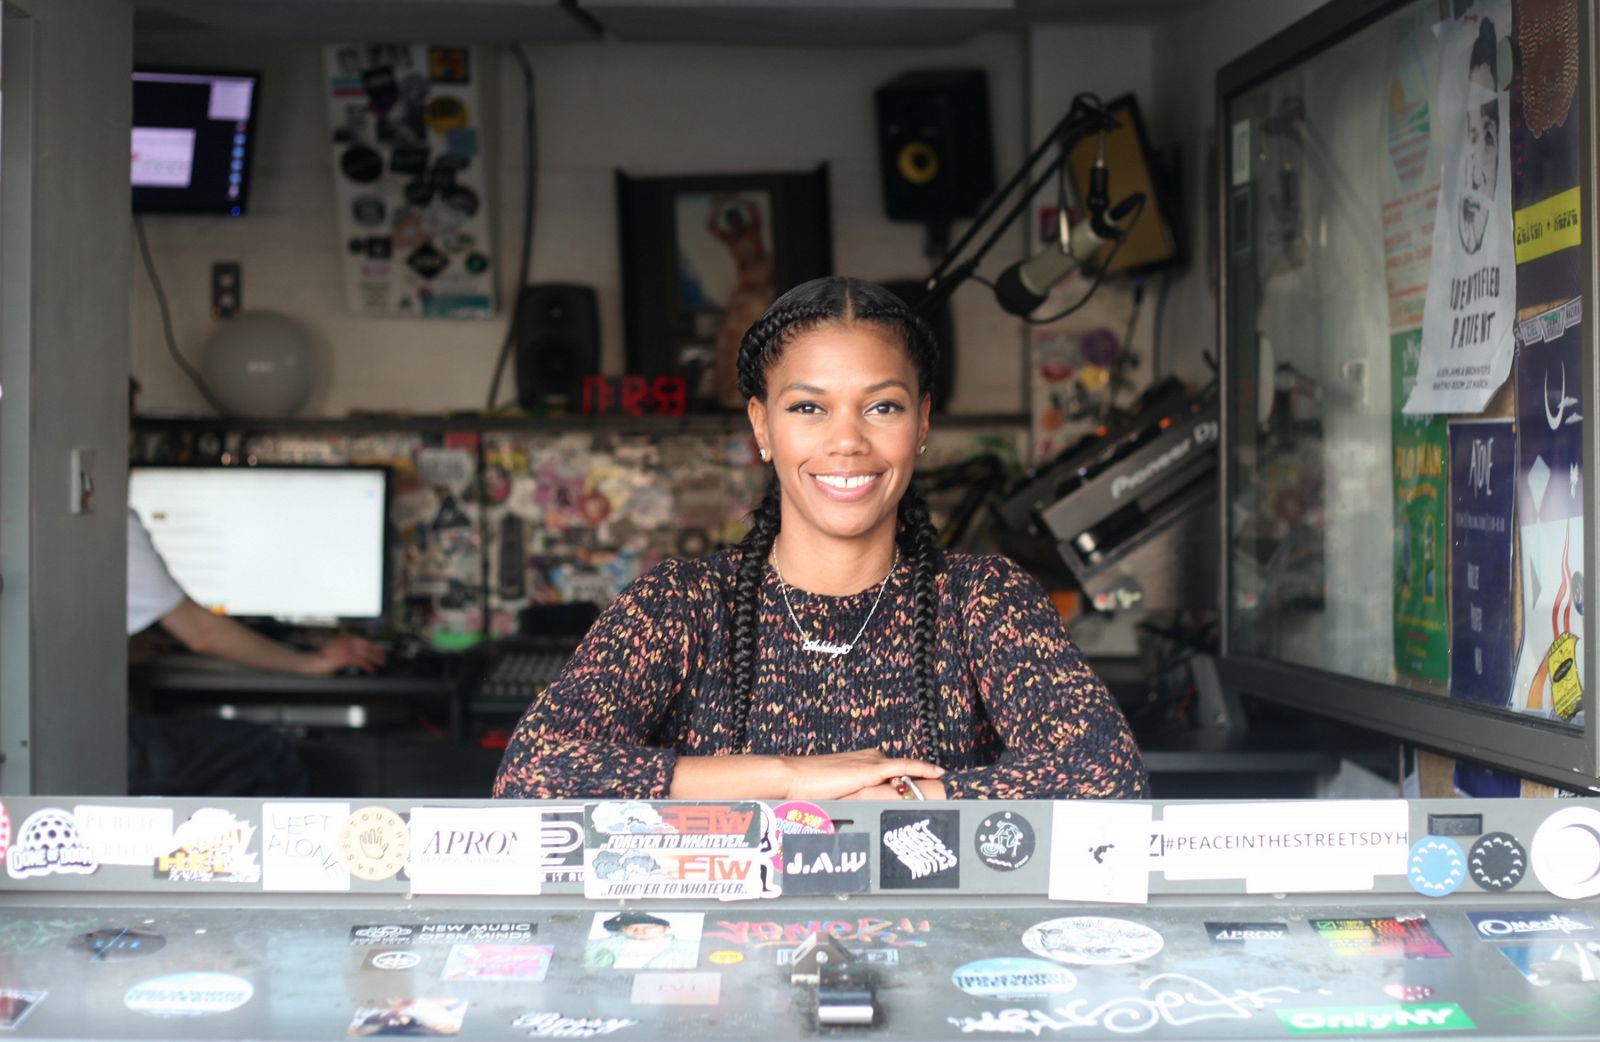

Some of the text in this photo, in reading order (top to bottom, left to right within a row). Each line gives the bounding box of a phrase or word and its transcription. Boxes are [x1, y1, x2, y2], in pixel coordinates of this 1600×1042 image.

[1450, 267, 1500, 310] IDENTIFIED
[1451, 312, 1495, 349] PATIENT
[271, 812, 334, 835] LEFT
[666, 834, 683, 849] TO
[677, 855, 752, 880] FTW
[787, 852, 866, 874] J.A.W
[665, 883, 679, 895] TO
[418, 931, 467, 942] OPEN
[476, 930, 531, 941] MINDS
[421, 924, 466, 933] NEW
[471, 922, 531, 933] MUSIC
[1216, 929, 1284, 940] APRON
